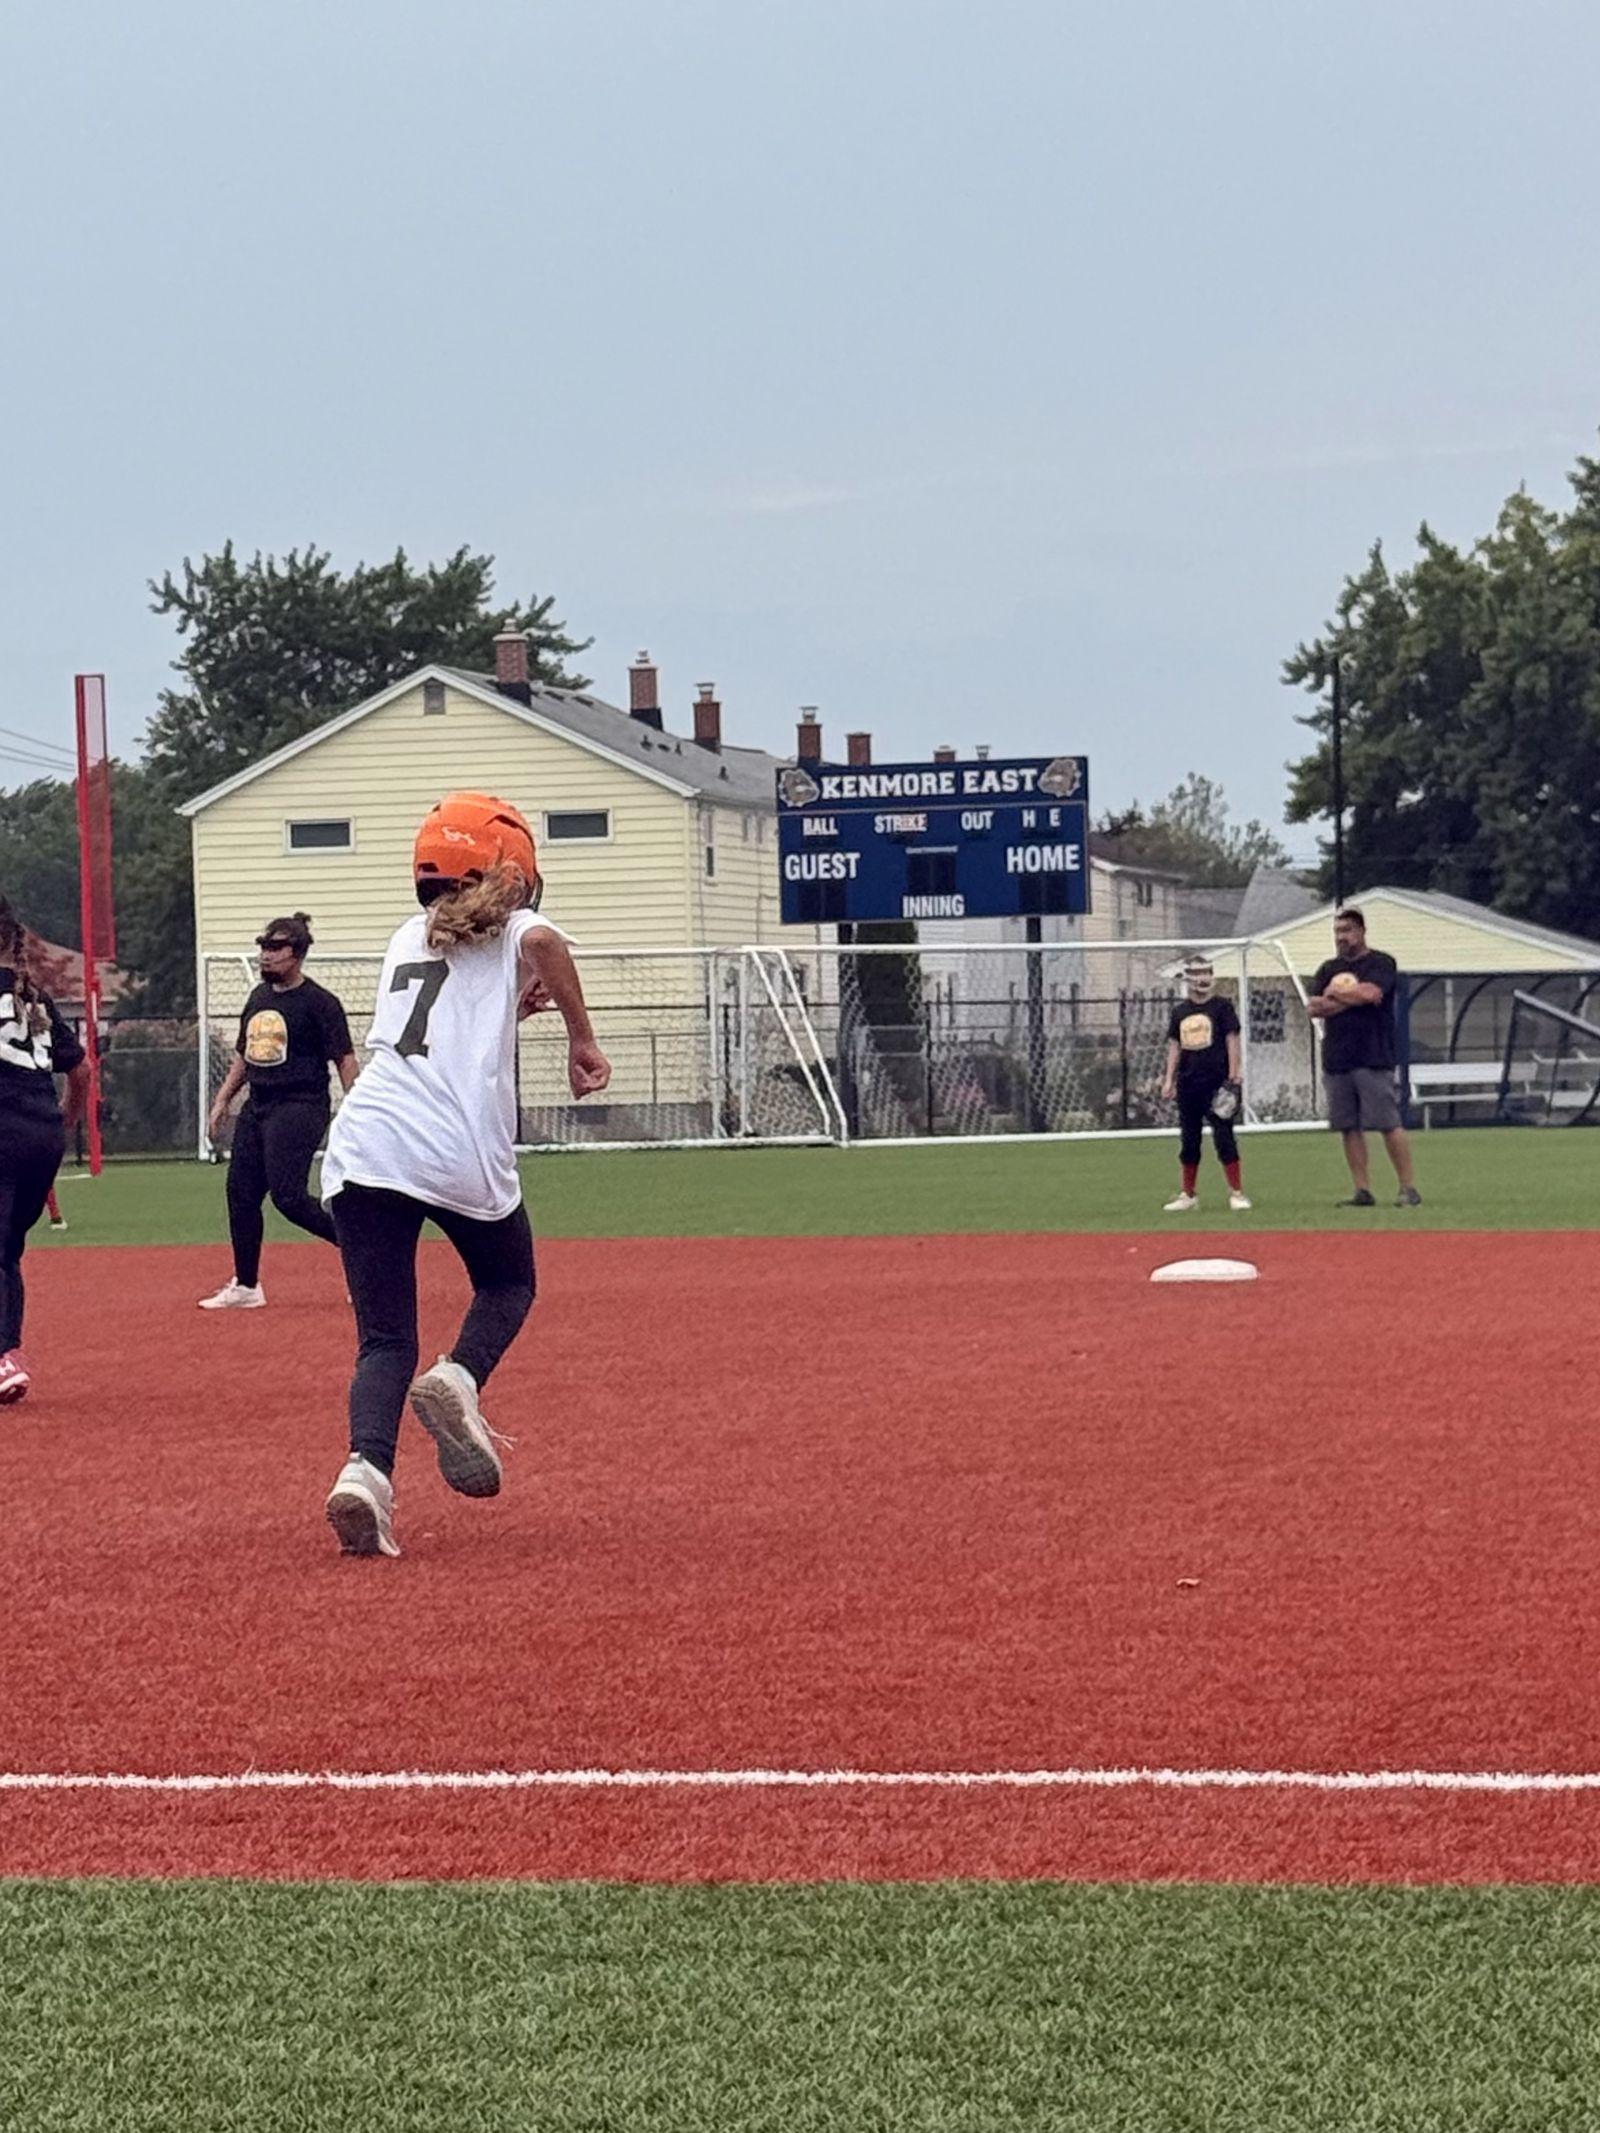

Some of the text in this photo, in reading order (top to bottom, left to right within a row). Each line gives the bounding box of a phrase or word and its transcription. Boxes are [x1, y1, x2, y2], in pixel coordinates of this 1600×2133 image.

[821, 768, 1037, 799] KENMORE EAST
[803, 816, 838, 836] BALL
[874, 814, 927, 833] STRIKE
[961, 811, 992, 831] OUT
[1023, 808, 1061, 827] H E
[785, 852, 861, 880] GUEST
[1007, 845, 1080, 873] HOME
[902, 895, 965, 918] INNING
[389, 958, 449, 1059] 7
